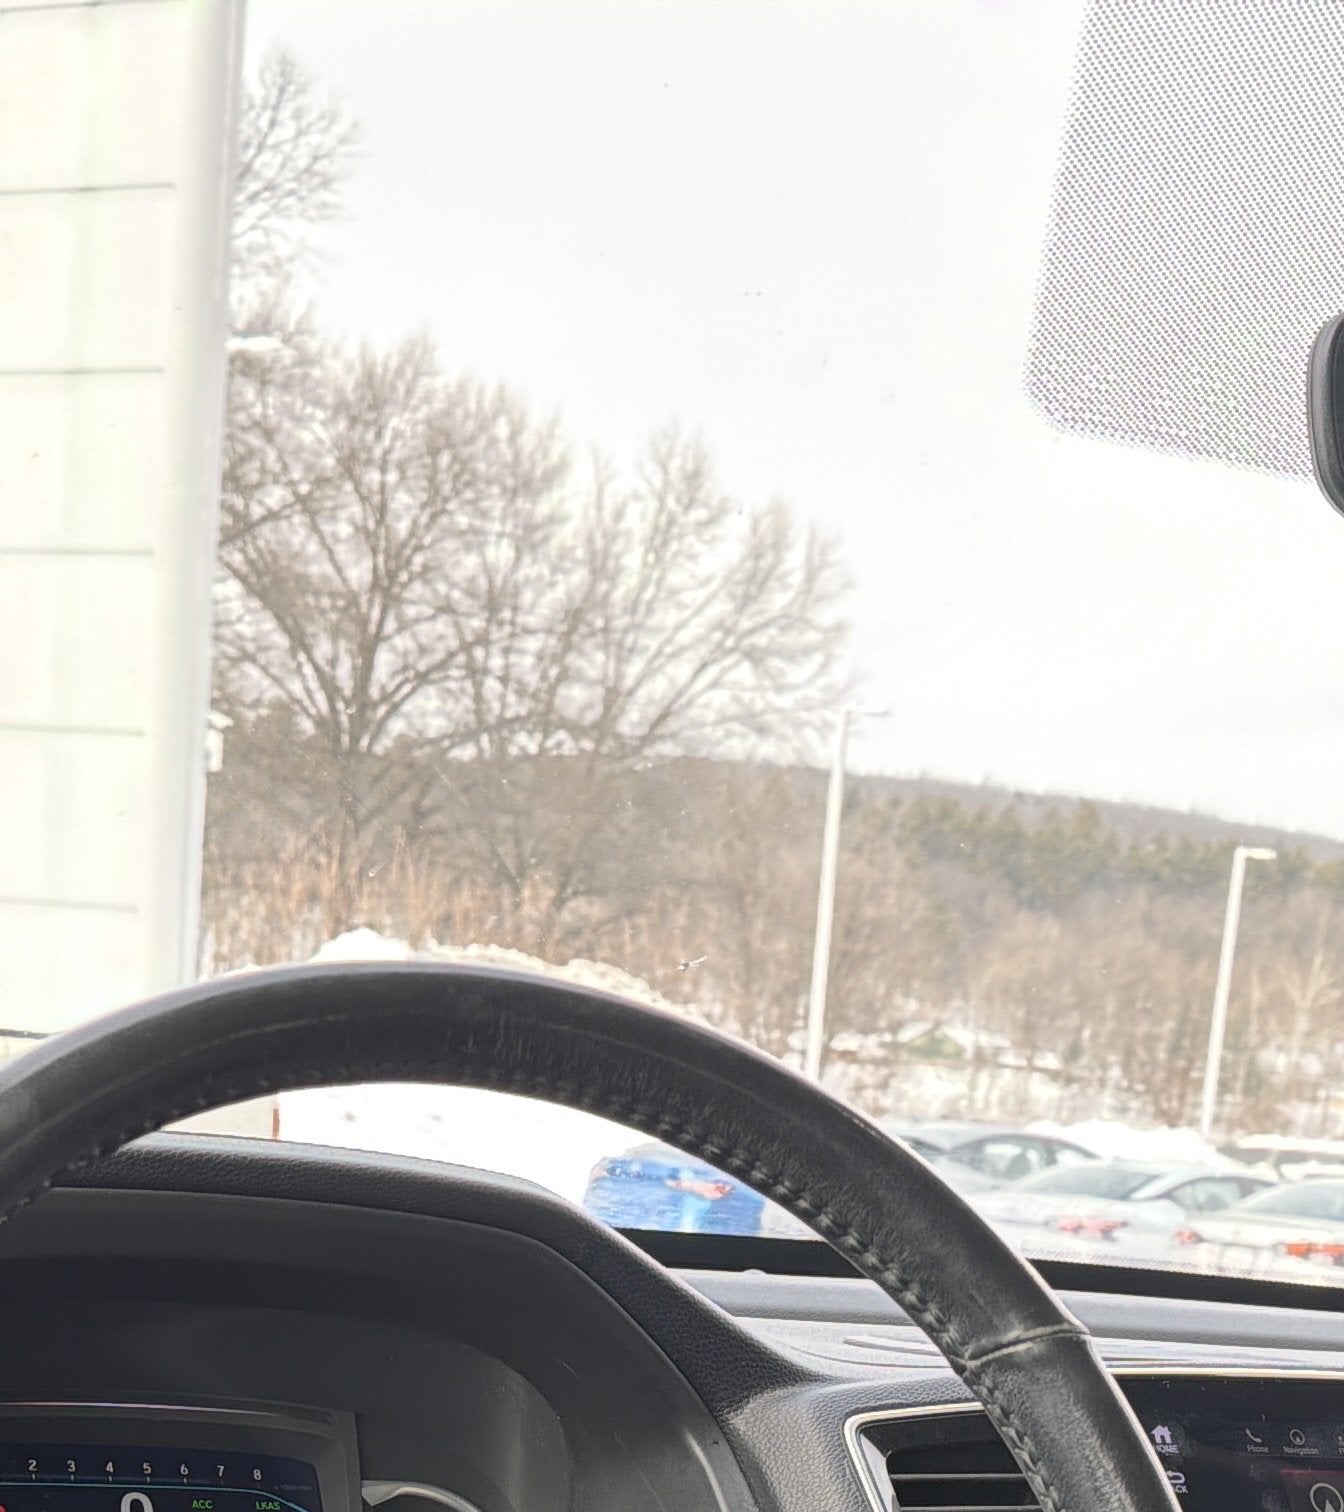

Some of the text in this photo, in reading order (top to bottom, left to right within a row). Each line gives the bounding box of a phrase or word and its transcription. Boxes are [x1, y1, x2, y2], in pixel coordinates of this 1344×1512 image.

[28, 1459, 37, 1472] 2
[67, 1460, 76, 1472] 3
[106, 1461, 114, 1473] 4
[143, 1462, 152, 1474] 5
[180, 1464, 189, 1475] 6
[216, 1465, 225, 1477] 7
[253, 1469, 262, 1481] 8
[192, 1500, 213, 1510] ACC
[256, 1501, 281, 1511] LKAS
